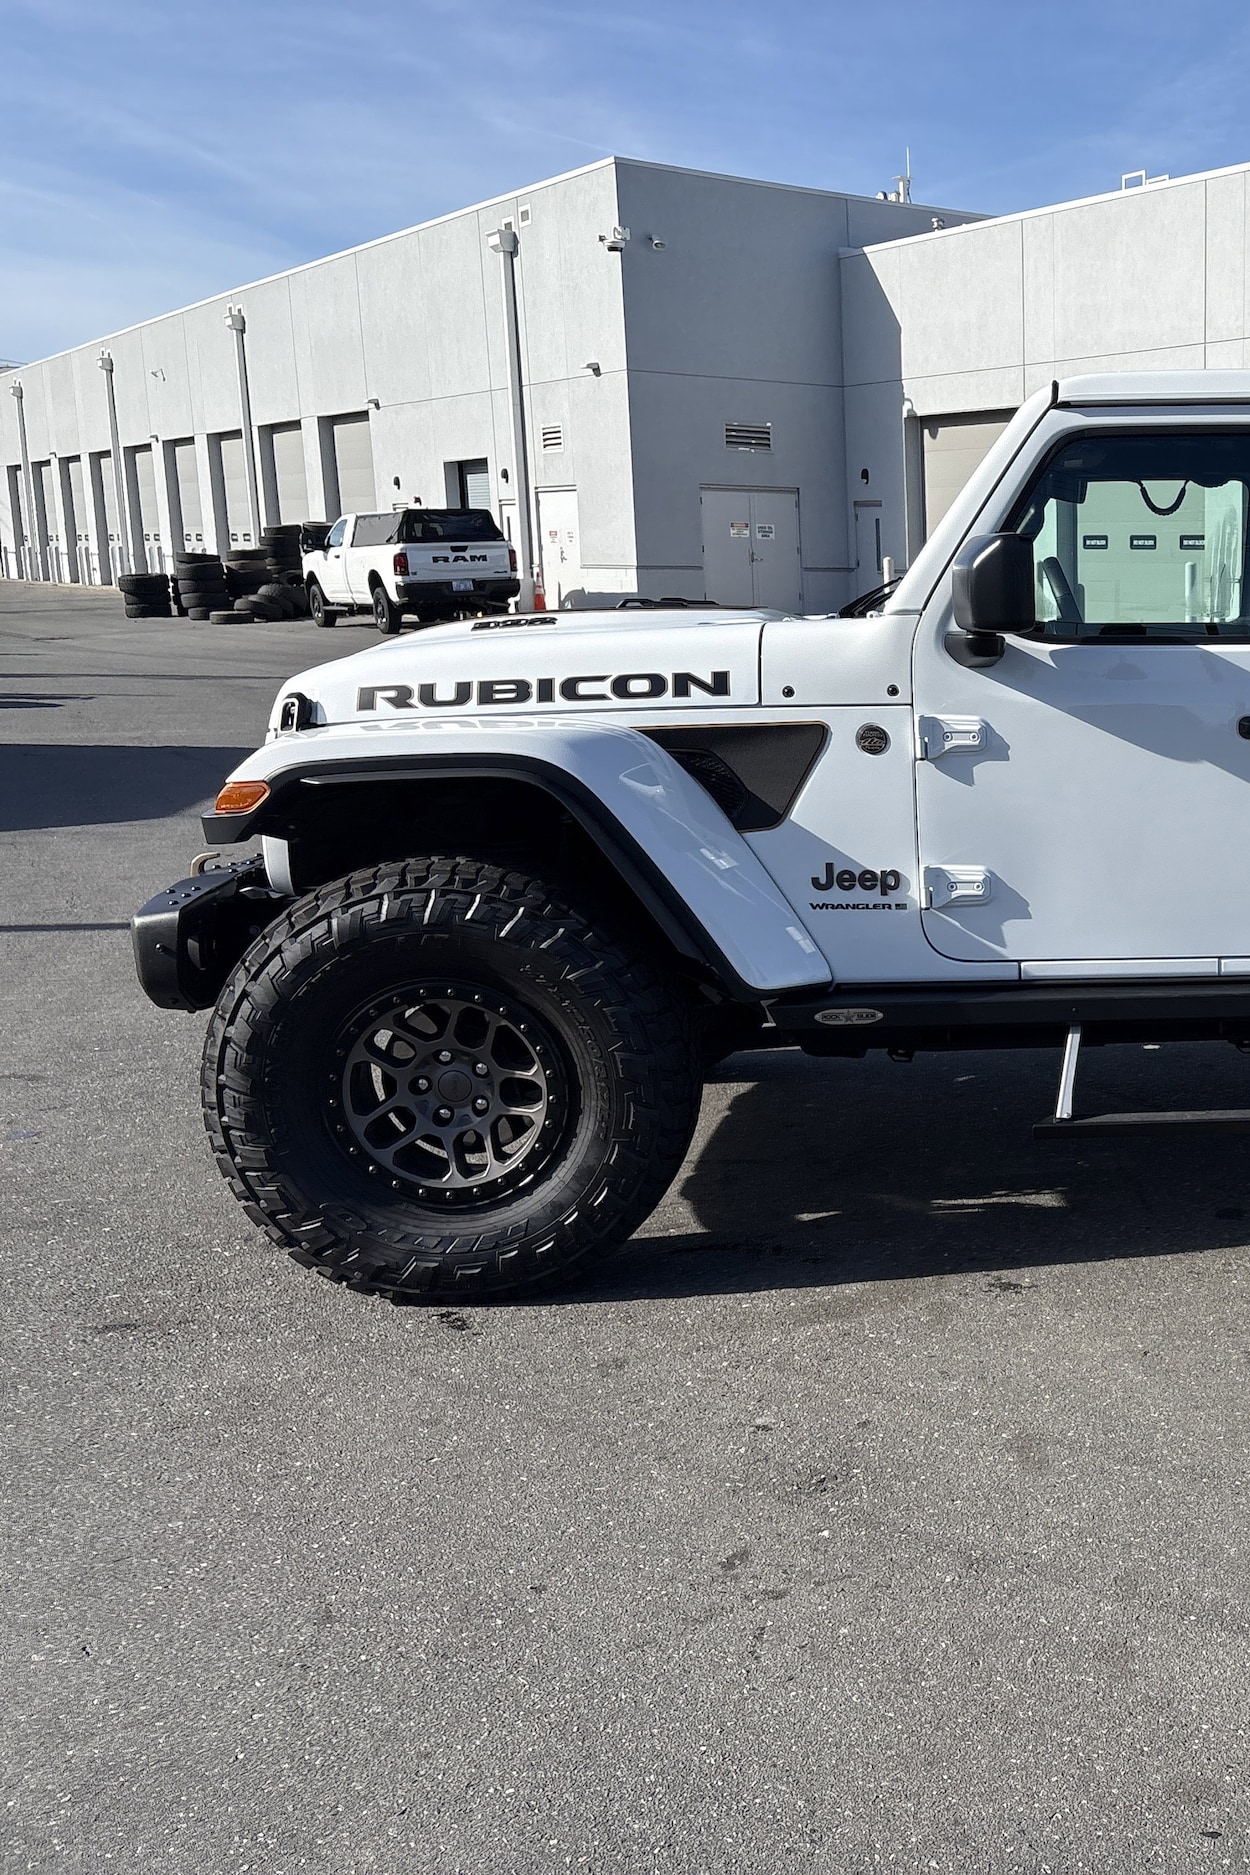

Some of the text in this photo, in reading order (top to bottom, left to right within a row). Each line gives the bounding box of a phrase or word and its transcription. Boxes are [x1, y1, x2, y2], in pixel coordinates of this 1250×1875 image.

[432, 554, 488, 563] RAM
[356, 670, 731, 711] RUBICON
[811, 862, 901, 896] Jeep
[809, 902, 892, 910] WRANGLER
